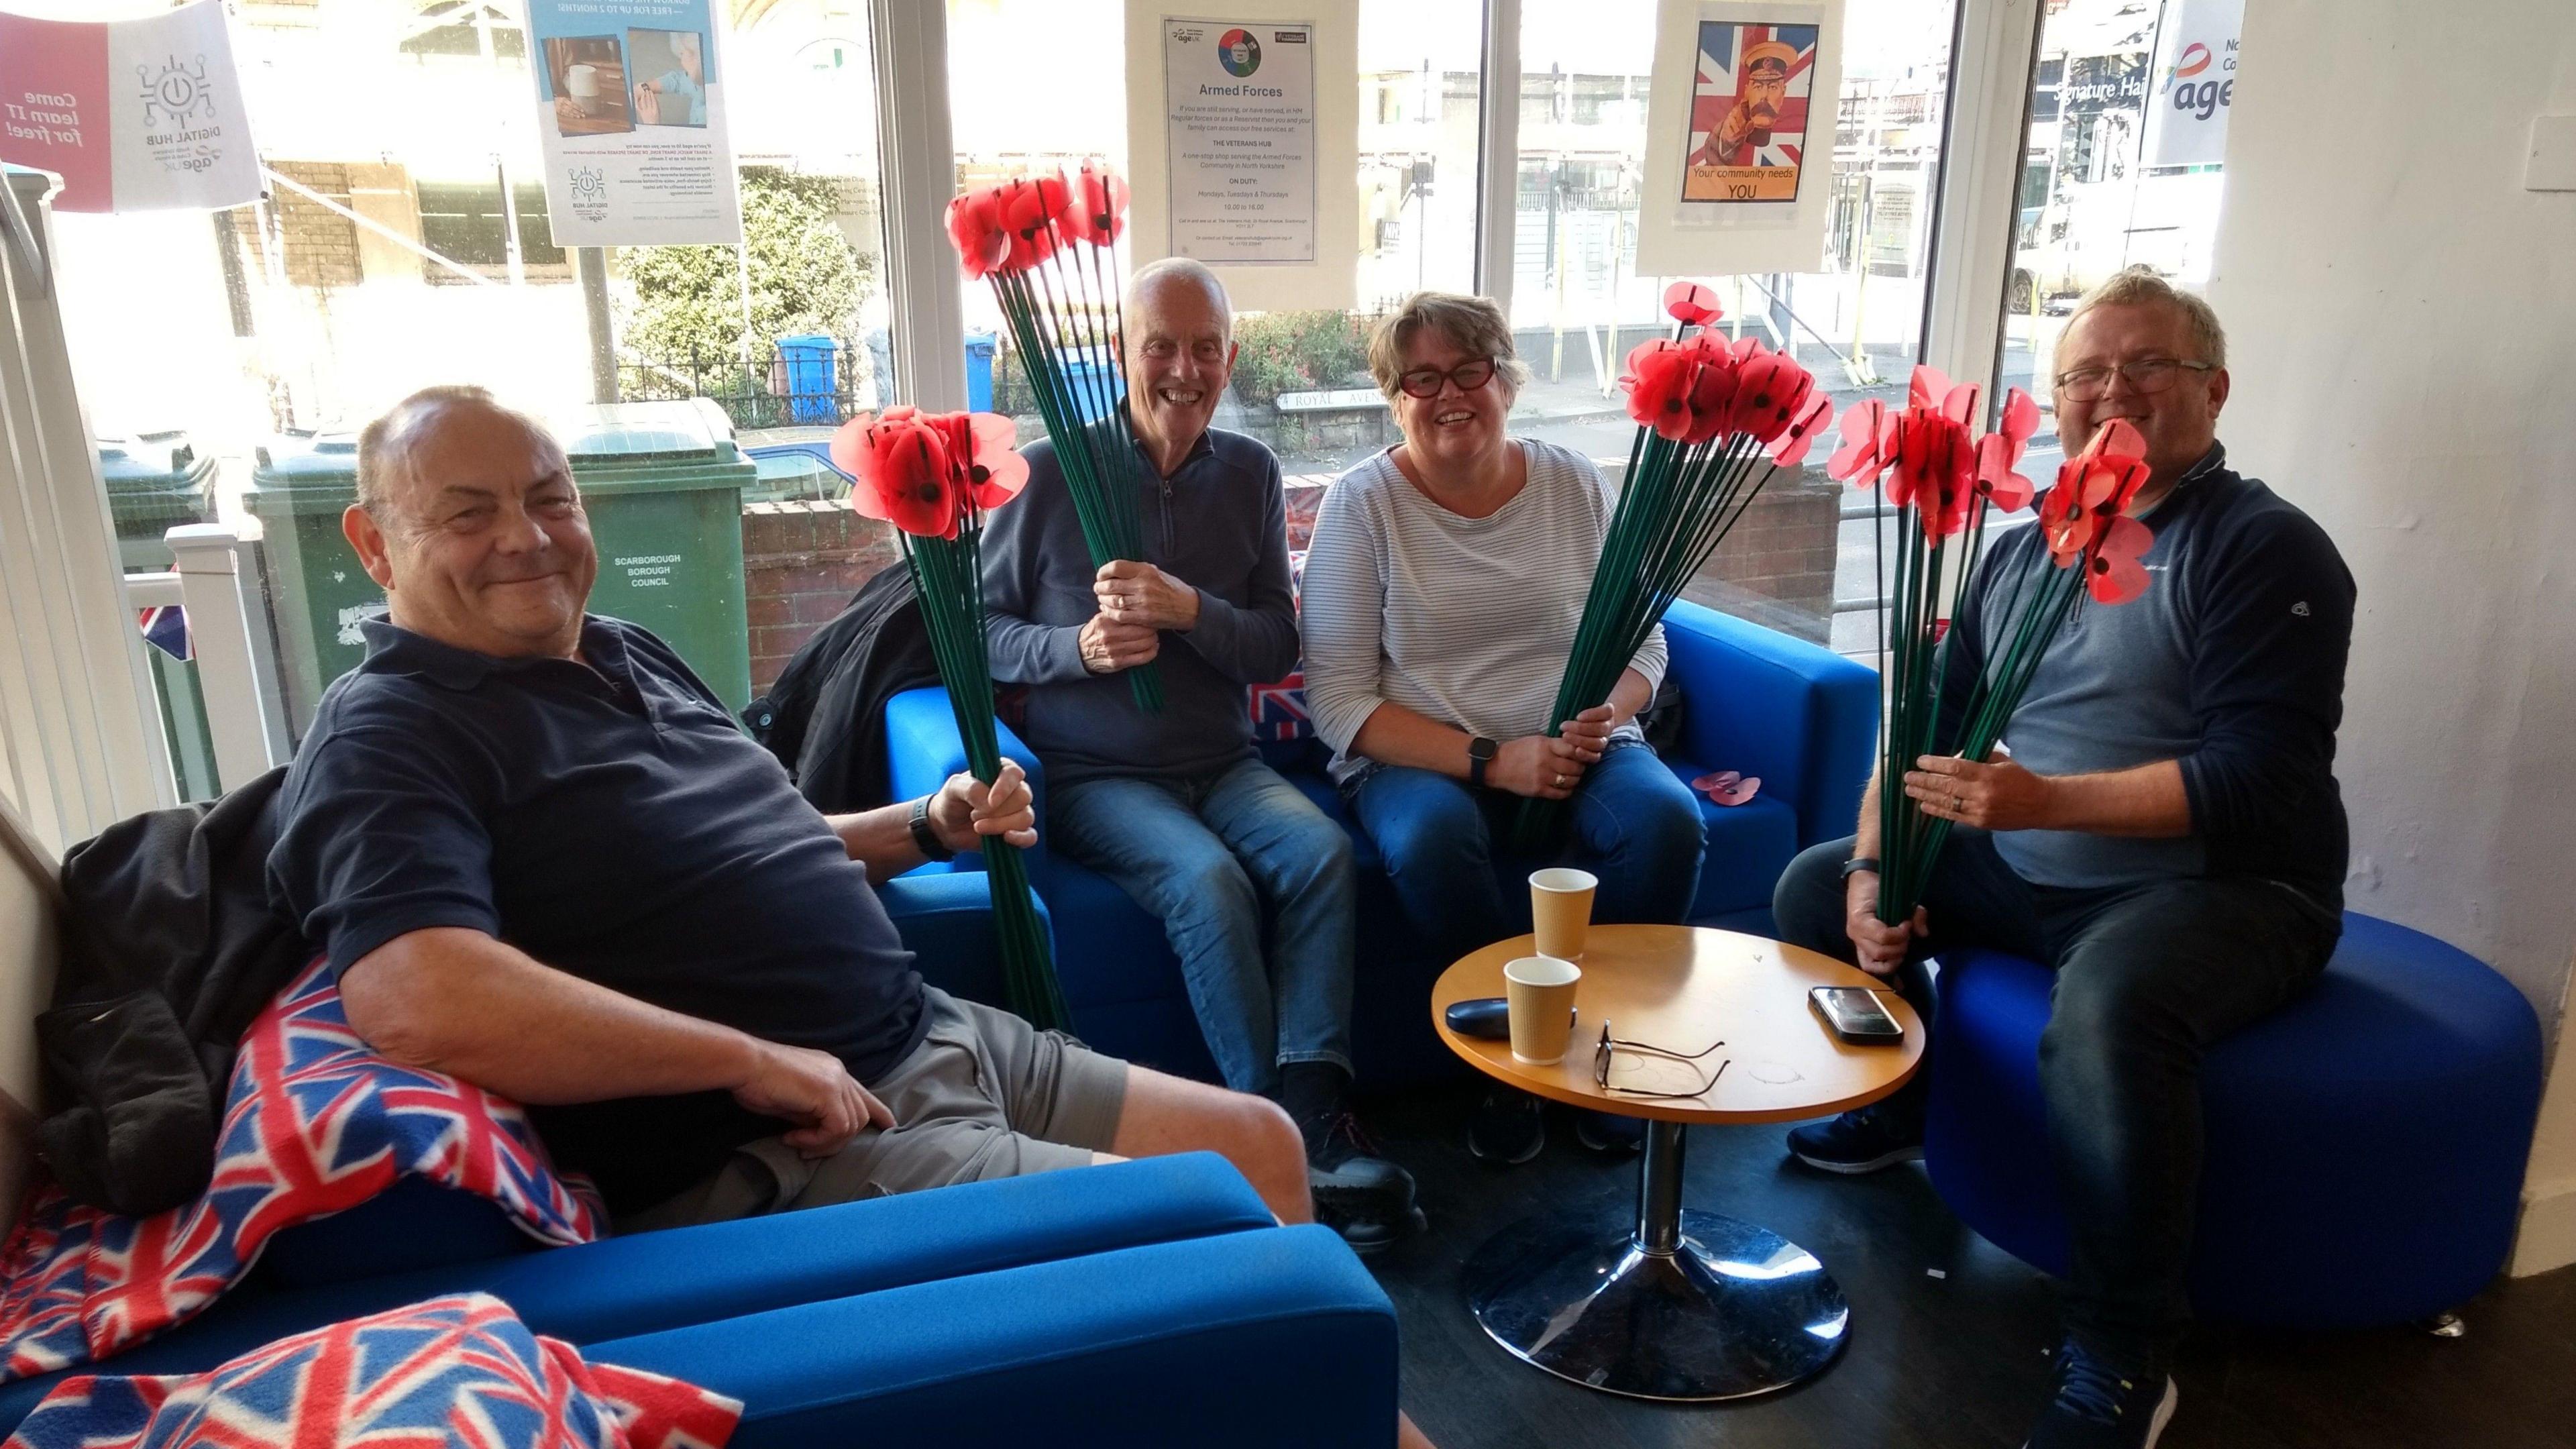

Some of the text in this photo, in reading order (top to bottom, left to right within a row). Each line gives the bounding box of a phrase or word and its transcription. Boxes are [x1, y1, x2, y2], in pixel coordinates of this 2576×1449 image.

[1199, 84, 1283, 97] Armed Forces
[2053, 81, 2116, 105] Sgnature
[2174, 78, 2234, 121] age
[1200, 162, 1234, 170] Community
[1693, 168, 1793, 180] Your community needs
[1728, 184, 1758, 199] YOU
[1295, 392, 1334, 407] ROYAL
[614, 554, 682, 566] SCARBOROUGH
[627, 566, 671, 576] BOROUGH
[631, 578, 669, 587] COUNCIL
